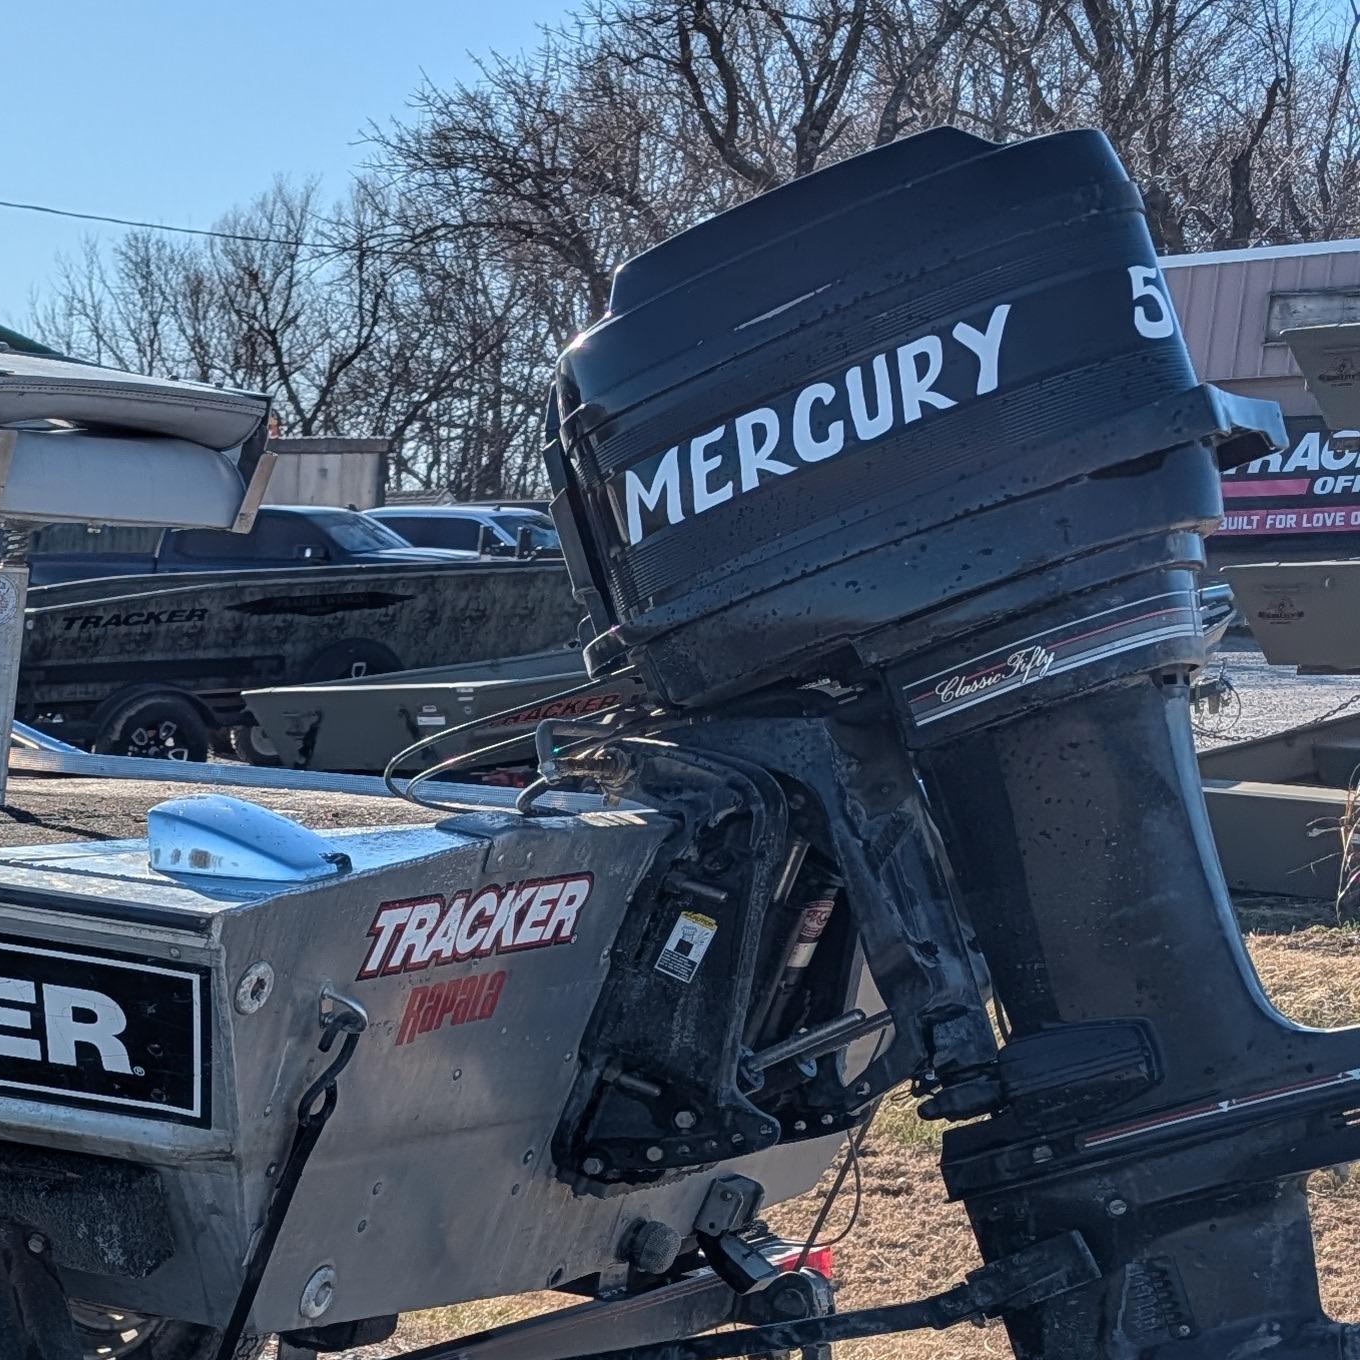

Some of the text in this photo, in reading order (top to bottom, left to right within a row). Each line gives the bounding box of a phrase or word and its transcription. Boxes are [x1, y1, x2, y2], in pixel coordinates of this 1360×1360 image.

[624, 304, 1012, 546] MERCURY
[1222, 429, 1360, 475] RAC
[1265, 514, 1297, 530] FOR
[1301, 512, 1346, 528] LOVE
[62, 607, 209, 632] TRACKER
[935, 645, 1056, 703] Classic Fifty
[358, 873, 593, 979] TRACKER
